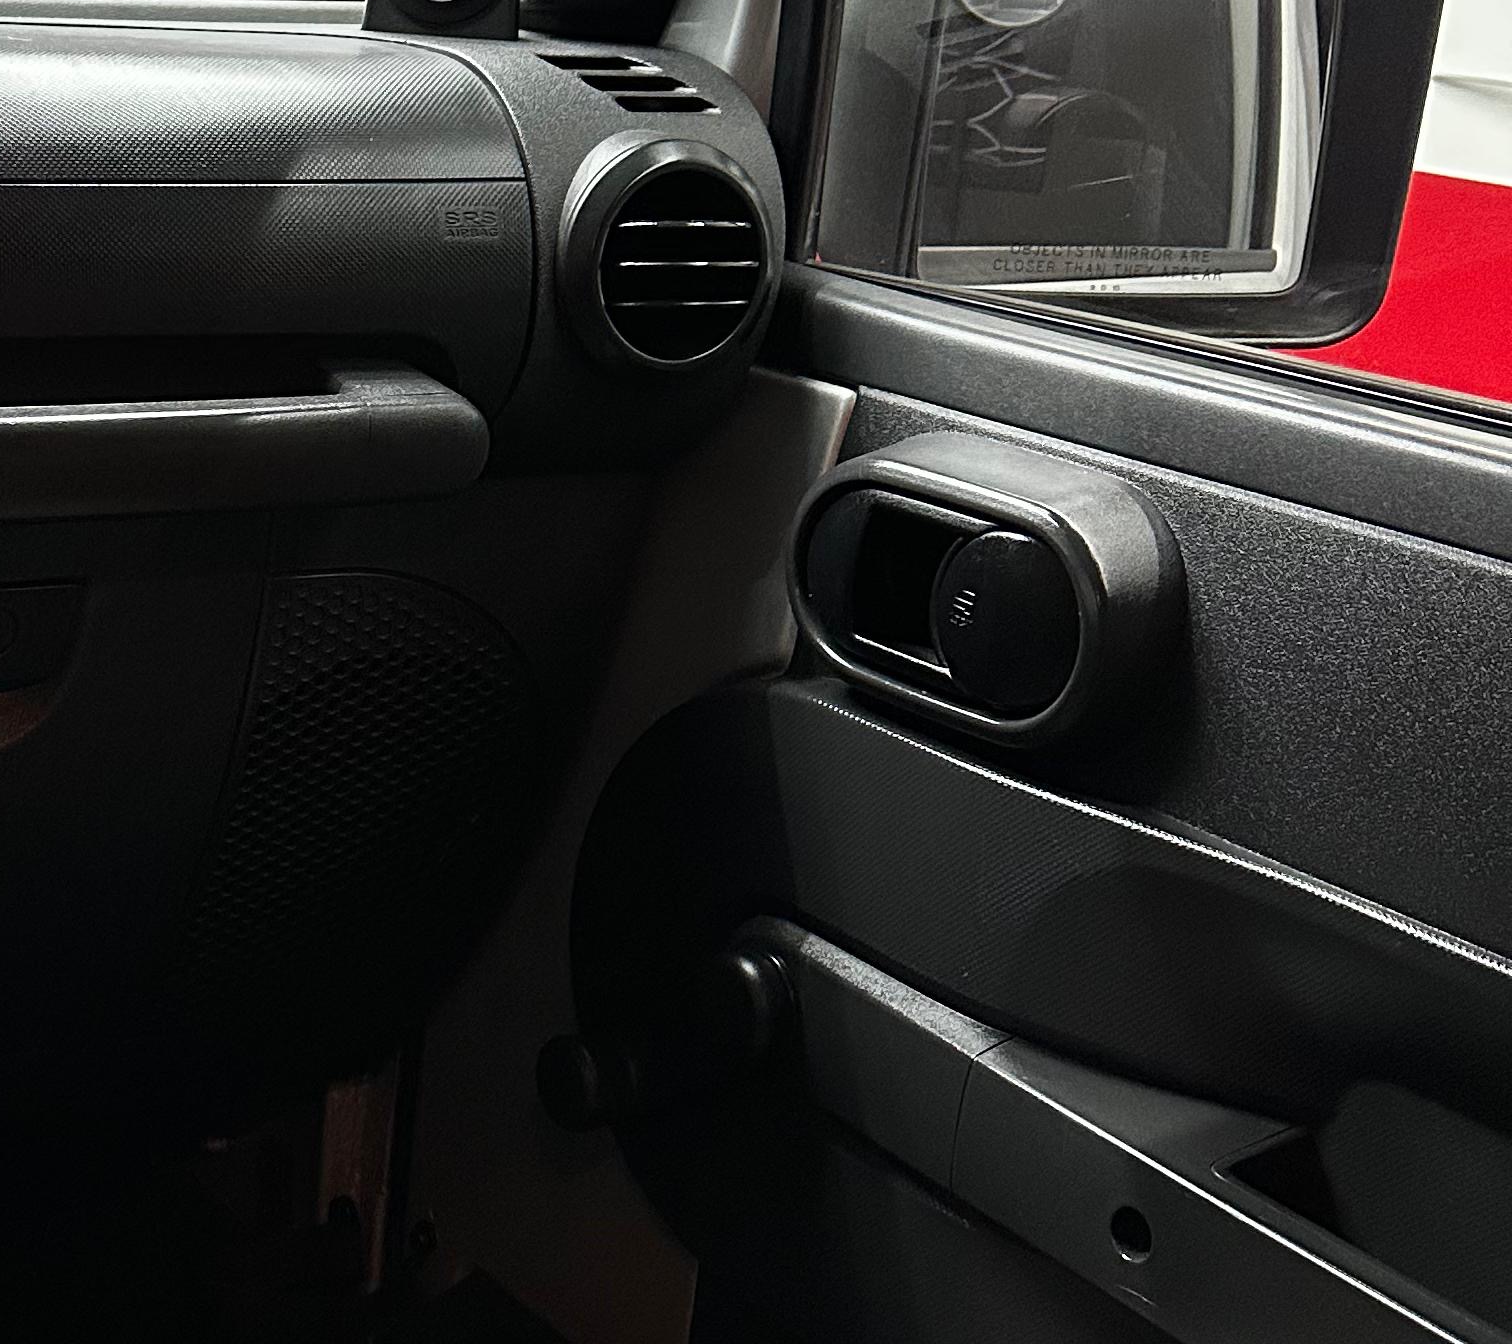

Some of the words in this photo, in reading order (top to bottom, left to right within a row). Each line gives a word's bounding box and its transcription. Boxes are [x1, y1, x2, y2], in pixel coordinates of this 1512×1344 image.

[445, 211, 497, 225] SRS
[447, 227, 498, 238] AIRBAG
[1010, 244, 1085, 259] OBJECTS
[1090, 245, 1106, 259] IN
[1111, 246, 1174, 263] MIRROR
[1179, 249, 1212, 264] ARE
[992, 258, 1056, 273] CLOSER
[1064, 261, 1107, 277] THAN
[1114, 262, 1156, 277] THEY
[1161, 266, 1223, 282] APPEAR
